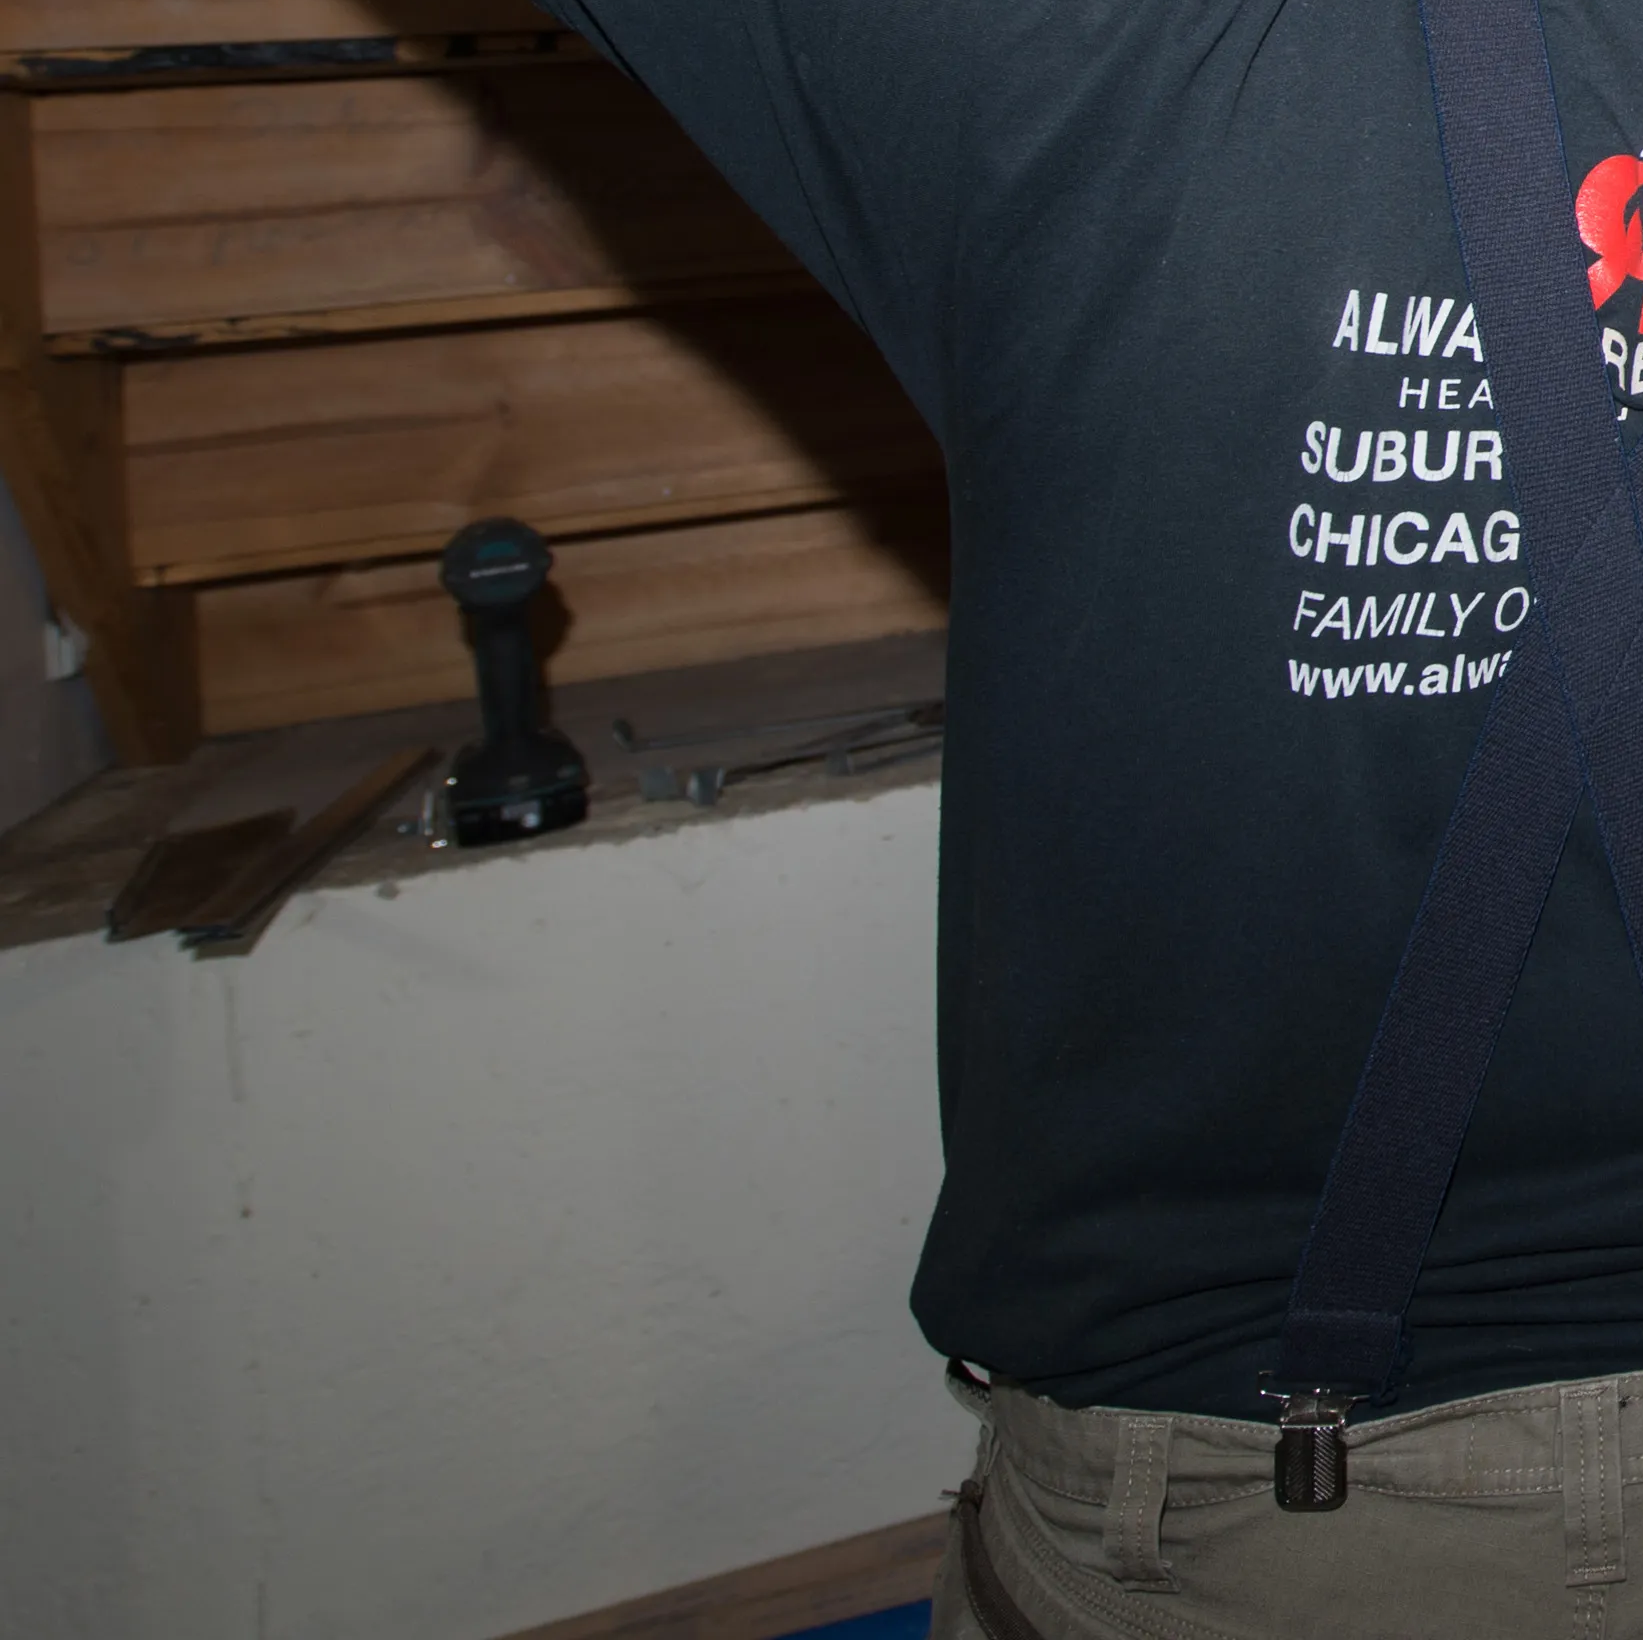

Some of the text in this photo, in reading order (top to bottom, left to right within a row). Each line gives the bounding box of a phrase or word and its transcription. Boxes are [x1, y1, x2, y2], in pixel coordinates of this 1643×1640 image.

[1332, 289, 1484, 362] ALWA
[1399, 377, 1494, 410] HEA
[1301, 421, 1504, 483] SUBUR
[1288, 503, 1521, 566] CHICAG
[1293, 590, 1486, 641] FAMILY
